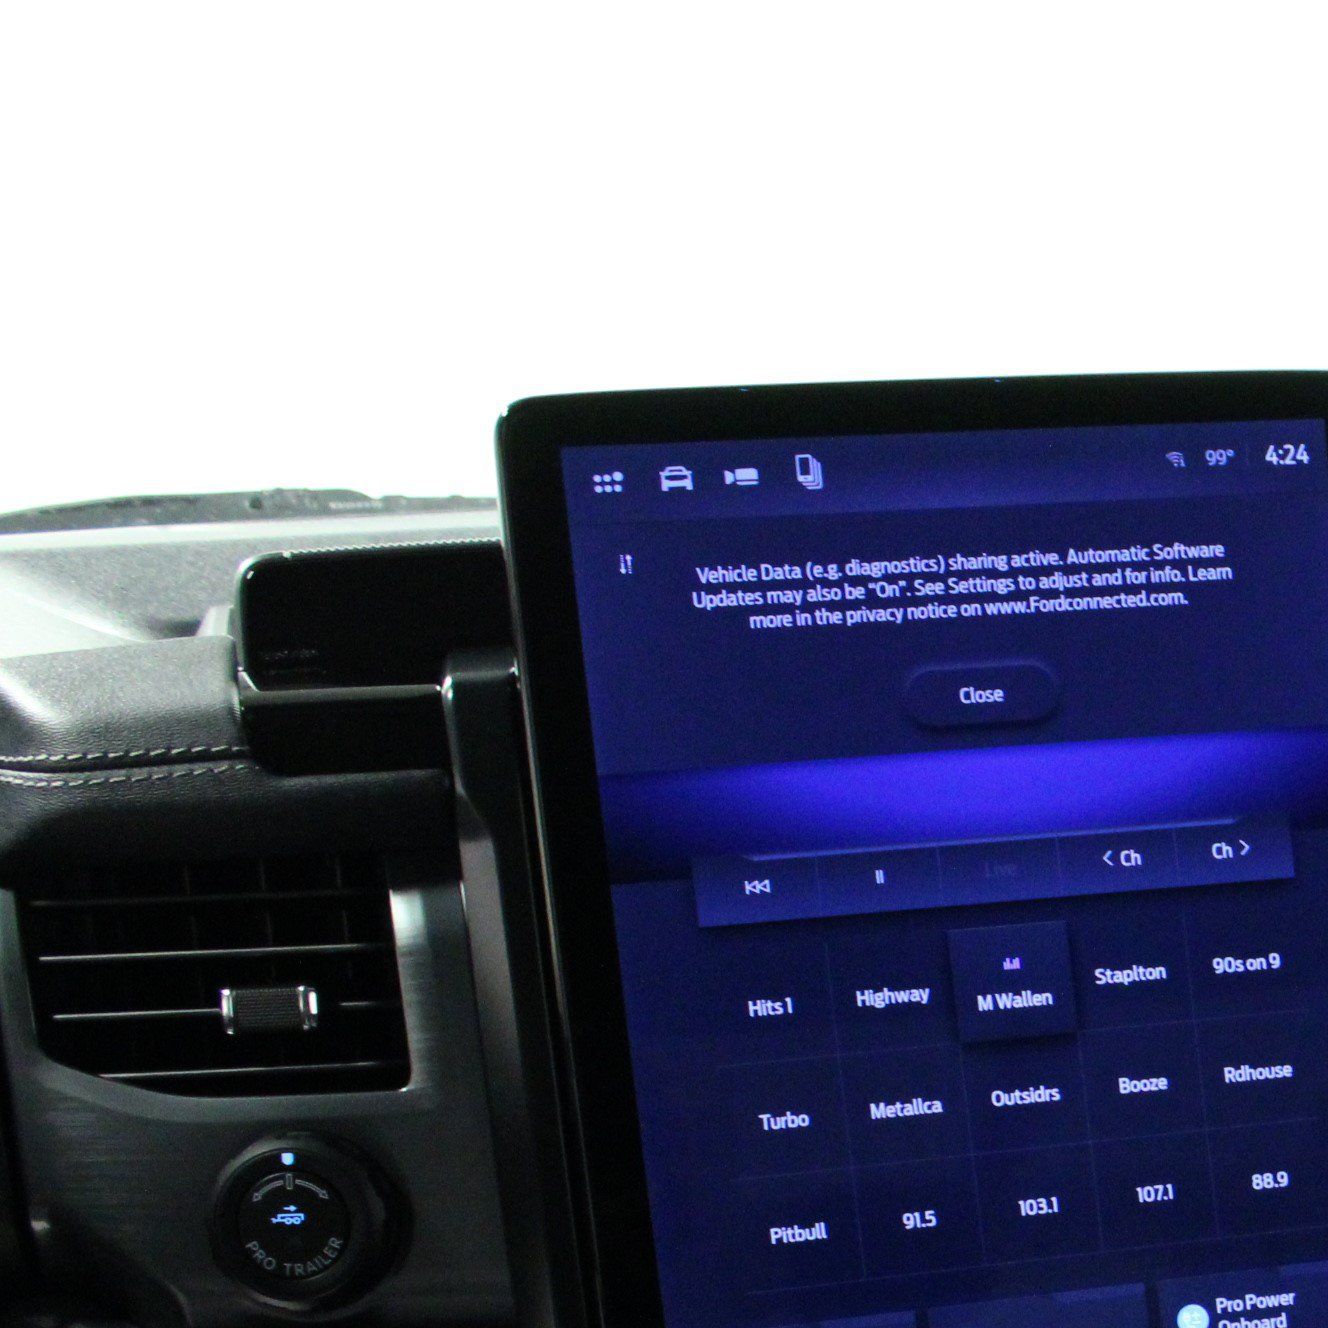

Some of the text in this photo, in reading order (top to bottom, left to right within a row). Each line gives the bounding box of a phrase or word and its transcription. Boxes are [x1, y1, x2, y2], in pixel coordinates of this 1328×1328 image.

[1265, 443, 1311, 466] 4:24
[695, 543, 1225, 584] Vehicle Data (e.g. diagnostics) sharing active. Automatic Software
[692, 590, 763, 611] Updates
[766, 589, 802, 606] may
[806, 584, 841, 601] also
[844, 583, 865, 600] be
[914, 579, 945, 596] See
[948, 577, 1016, 595] Settings
[1017, 575, 1036, 591] to
[1039, 571, 1088, 592] adjust
[1091, 570, 1122, 586] and
[1124, 568, 1148, 584] for
[1150, 566, 1186, 583] info.
[1187, 565, 1233, 582] Learn
[749, 612, 794, 629] more
[795, 609, 812, 626] in
[814, 608, 843, 626] the
[846, 605, 903, 627] privacy
[906, 603, 958, 620] notice
[960, 602, 982, 617] on
[959, 686, 1004, 705] Close
[1120, 849, 1142, 867] Ch
[1211, 842, 1234, 860] Ch
[1212, 953, 1281, 975] 90s on 9
[1095, 964, 1167, 987] Staplton
[747, 996, 793, 1018] Hits 1
[856, 983, 930, 1009] Highway
[976, 989, 1053, 1013] M Wallen
[1224, 1061, 1293, 1083] Rdhouse
[991, 1084, 1061, 1107] Outsidrs
[1118, 1074, 1168, 1095] Booze
[870, 1097, 943, 1120] Metallca
[759, 1111, 809, 1132] Turbo
[1252, 1171, 1289, 1191] 88.9
[1135, 1183, 1174, 1203] 107.1
[1018, 1197, 1059, 1217] 103.1
[902, 1210, 937, 1230] 91.5
[770, 1222, 827, 1245] Pitbull
[245, 1237, 343, 1276] PRO TRAILER
[1215, 1289, 1296, 1315] Pro Power
